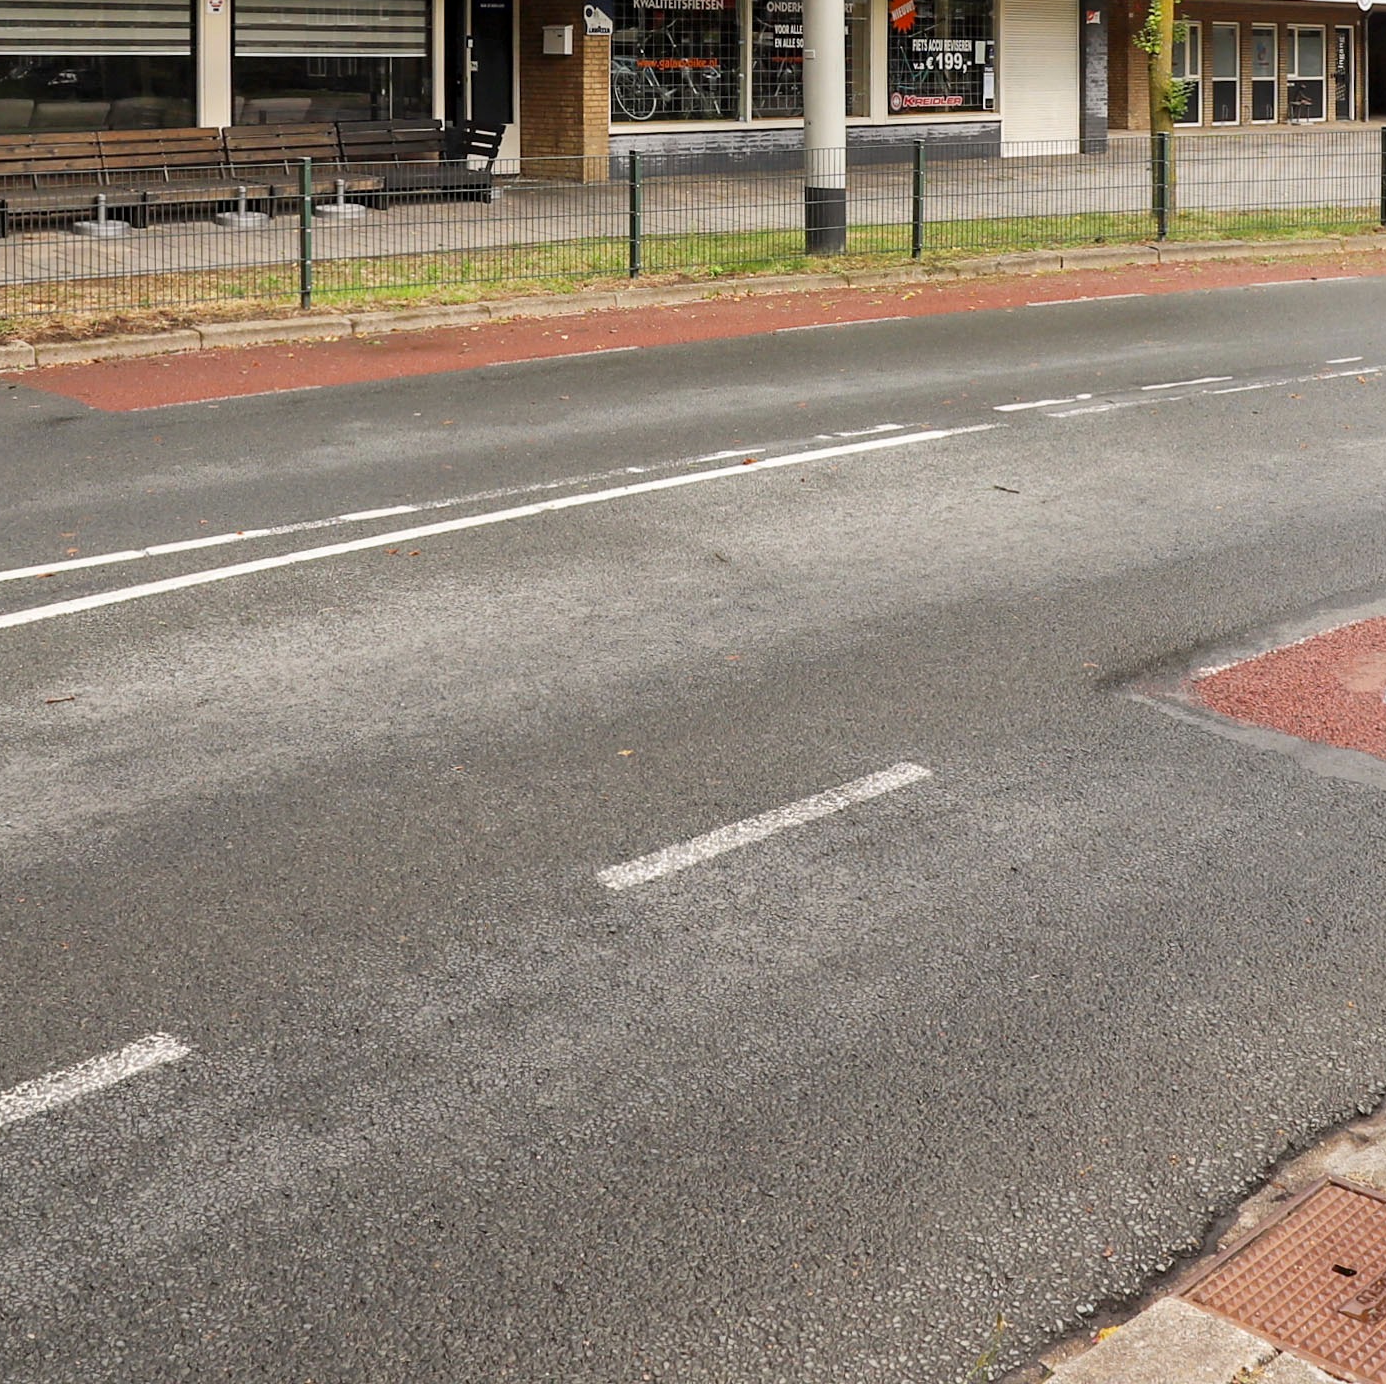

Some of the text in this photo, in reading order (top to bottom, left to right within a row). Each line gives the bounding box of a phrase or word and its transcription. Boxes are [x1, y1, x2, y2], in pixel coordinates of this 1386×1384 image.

[774, 24, 803, 34] VOOR ALLE
[775, 38, 782, 48] EN
[783, 38, 795, 48] ALLE
[912, 39, 972, 52] FIETS ACCU REVISEREN
[903, 95, 963, 107] KREIDLER
